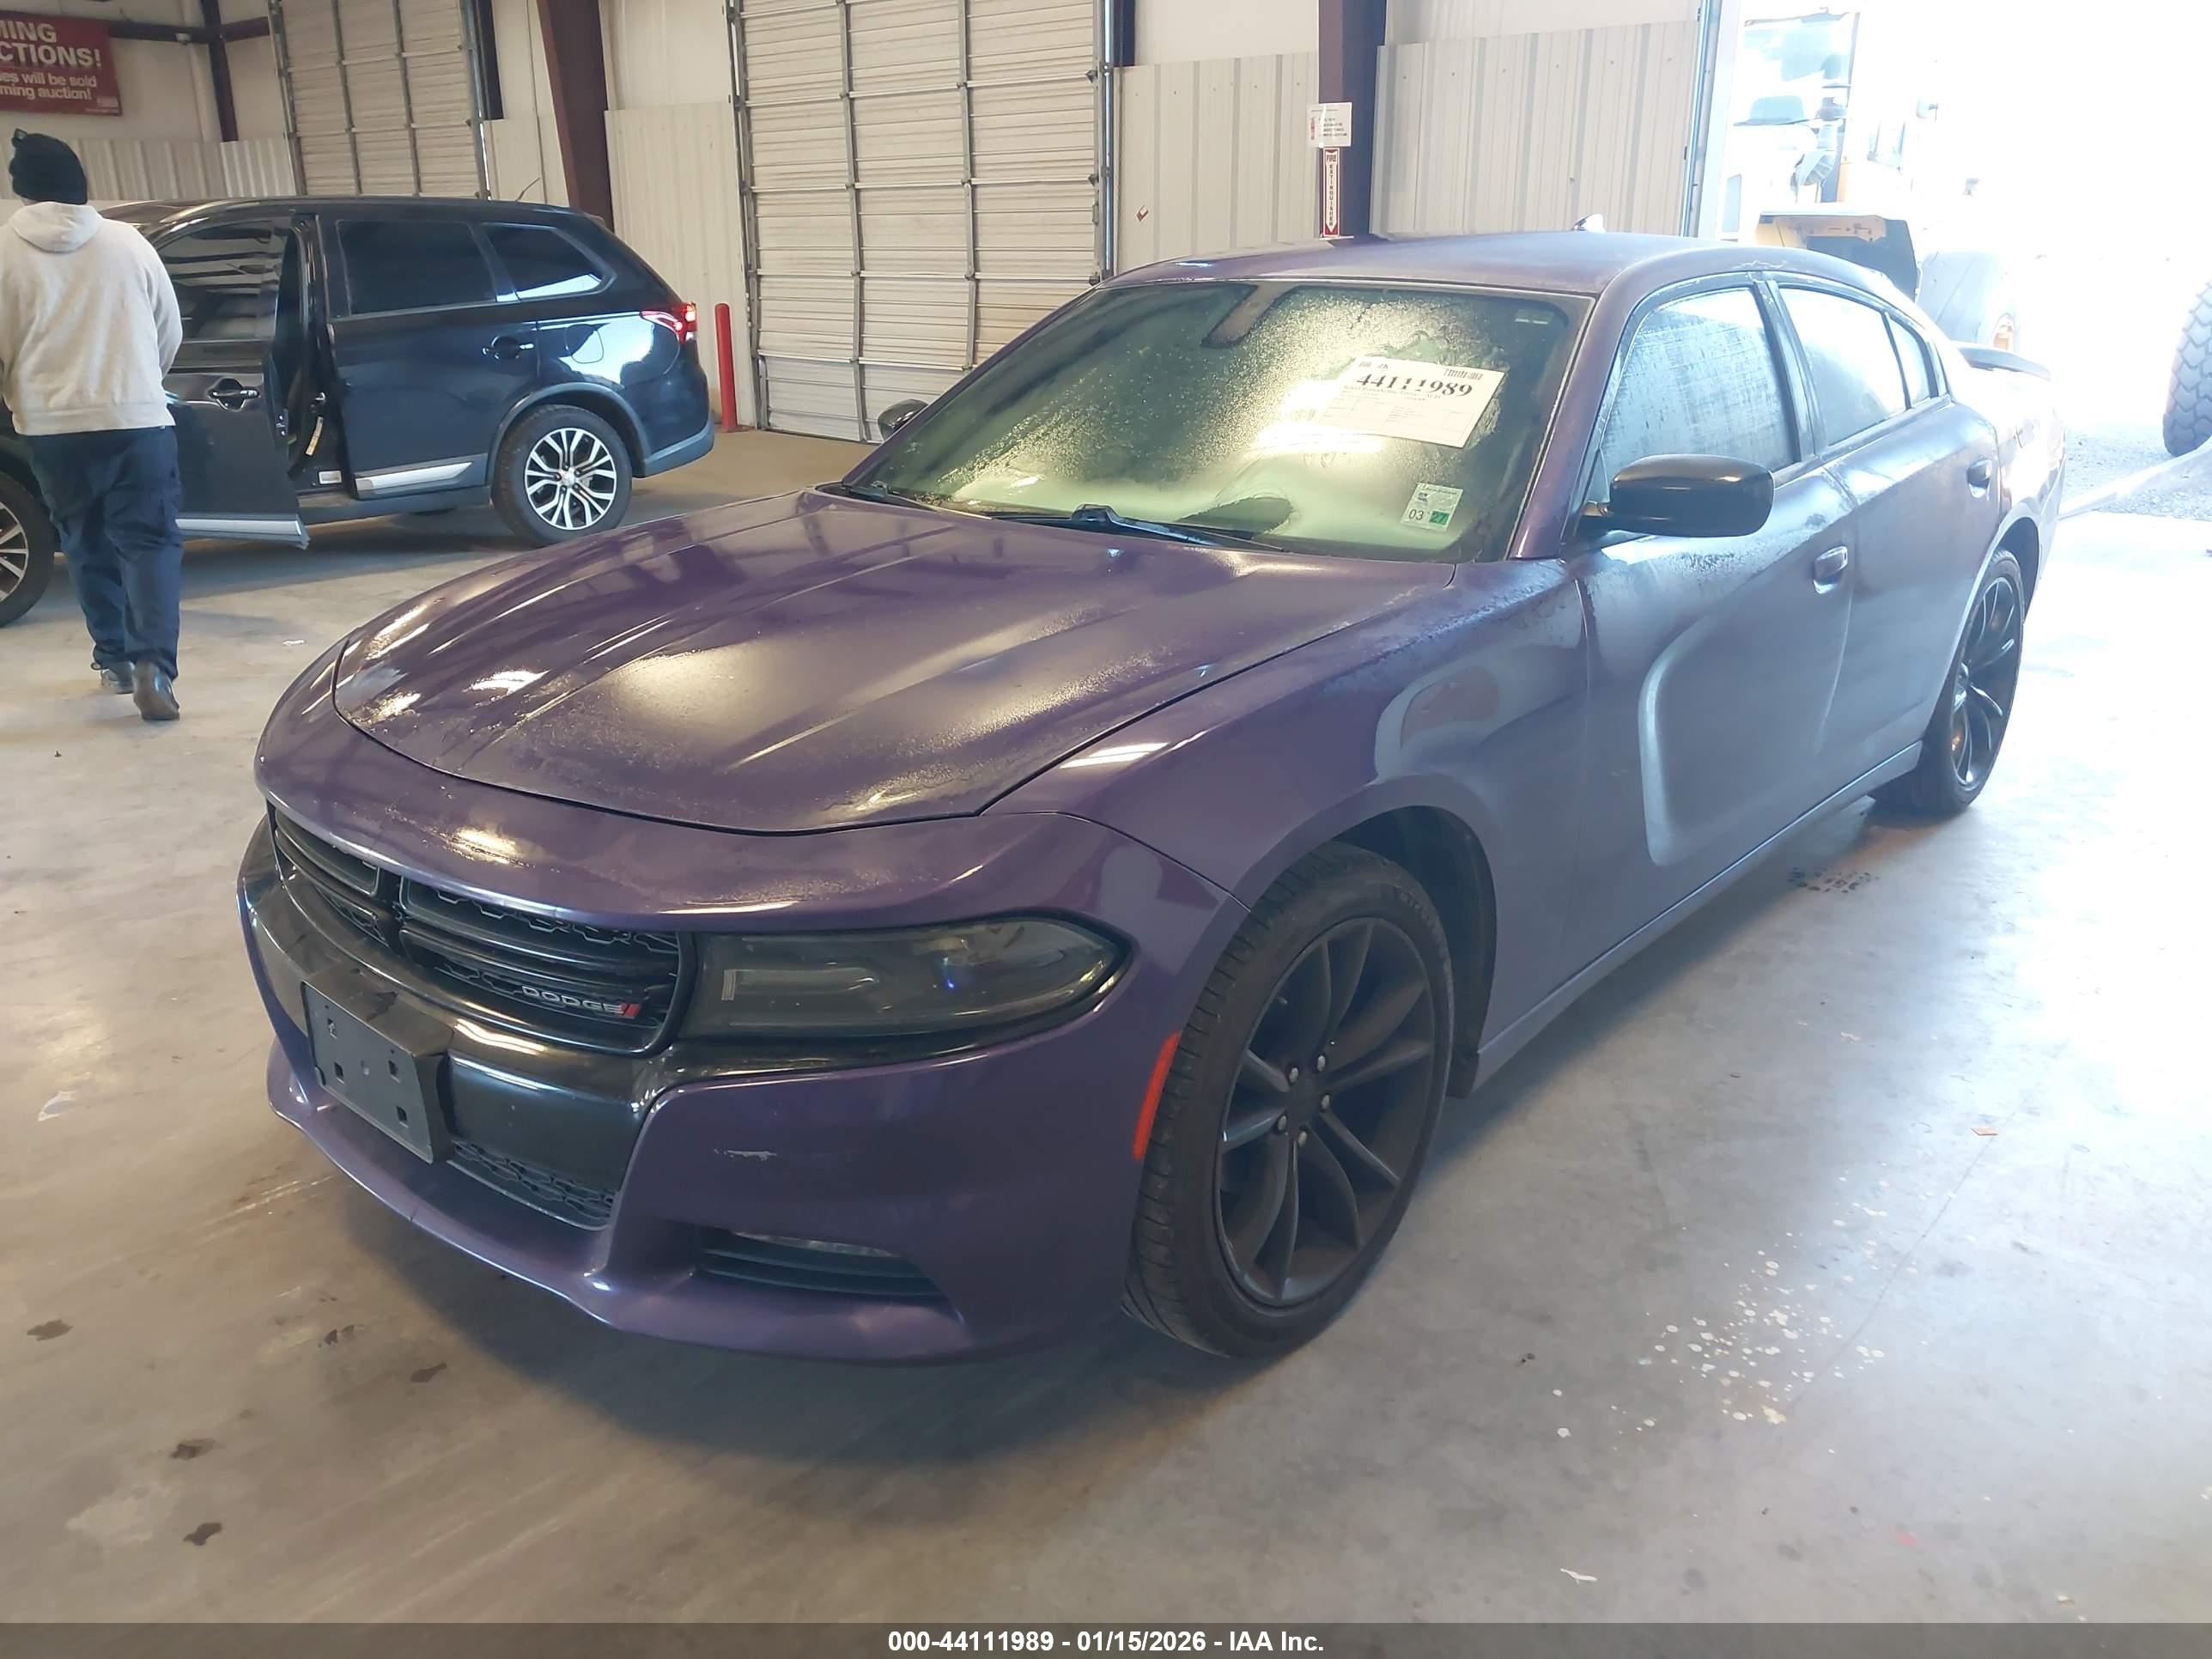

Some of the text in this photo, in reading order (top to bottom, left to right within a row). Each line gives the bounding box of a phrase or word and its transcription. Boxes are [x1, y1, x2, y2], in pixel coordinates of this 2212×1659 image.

[0, 40, 101, 68] CTIONS!
[0, 71, 97, 88] es will be sold
[38, 87, 92, 100] auction!
[1356, 373, 1474, 398] 44111989
[1408, 508, 1425, 520] 03
[521, 985, 625, 1014] DODGE
